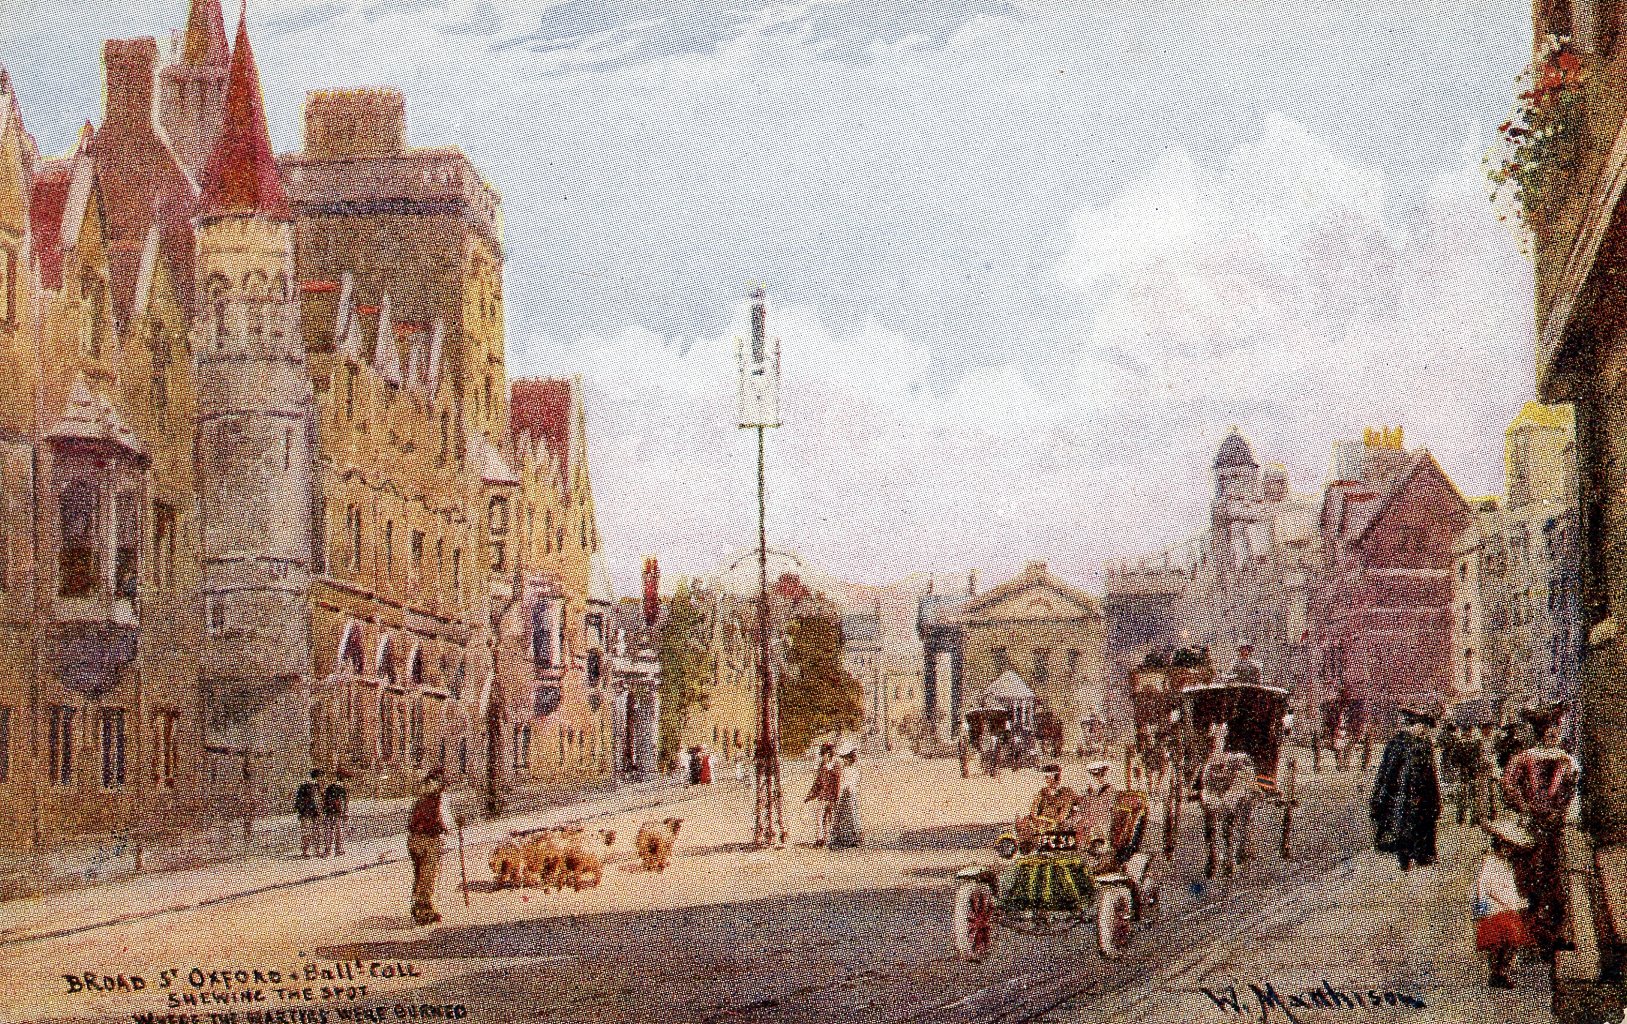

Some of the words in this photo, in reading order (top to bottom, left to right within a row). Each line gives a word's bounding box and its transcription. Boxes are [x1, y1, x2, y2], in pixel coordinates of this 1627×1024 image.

[62, 971, 147, 995] BROAD
[276, 986, 315, 1002] THE
[320, 984, 369, 1001] SPOT
[336, 1005, 389, 1022] WERE
[393, 1003, 469, 1020] BURNED
